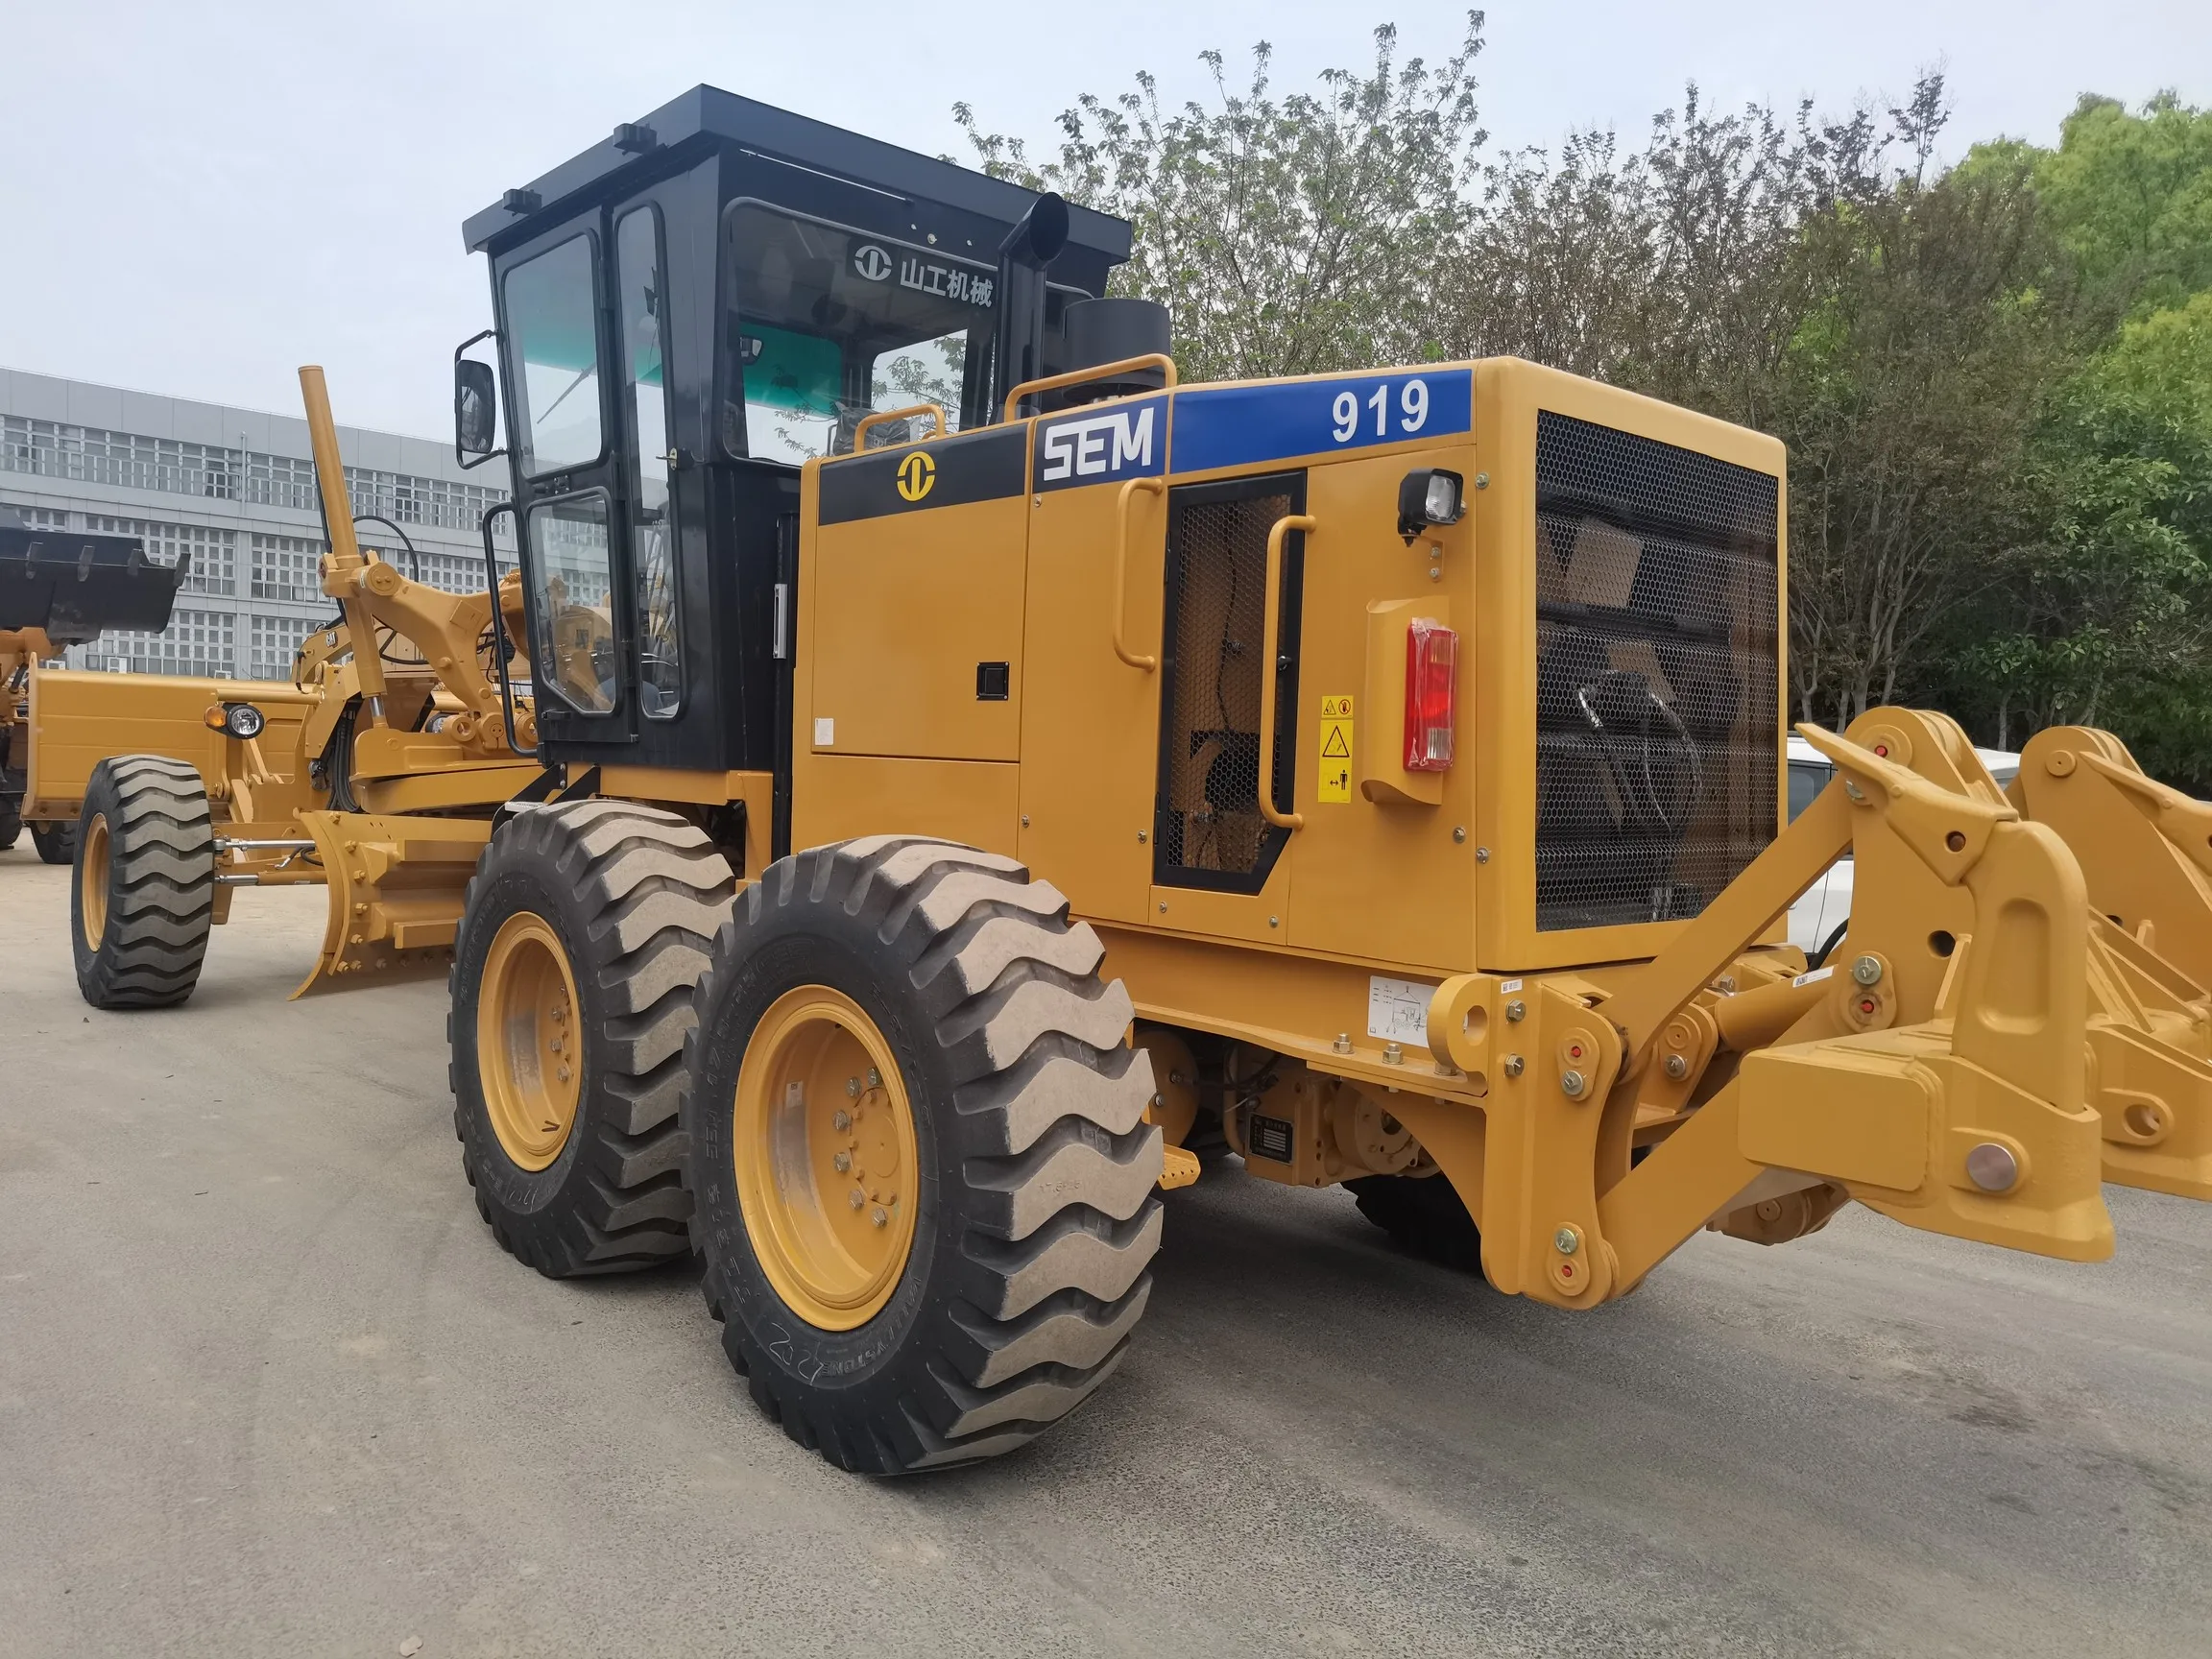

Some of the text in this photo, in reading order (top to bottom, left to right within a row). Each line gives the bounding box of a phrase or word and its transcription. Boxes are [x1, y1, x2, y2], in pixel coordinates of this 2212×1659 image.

[900, 257, 994, 308] 山工机械
[1333, 380, 1430, 443] 919
[1044, 407, 1154, 481] SEM
